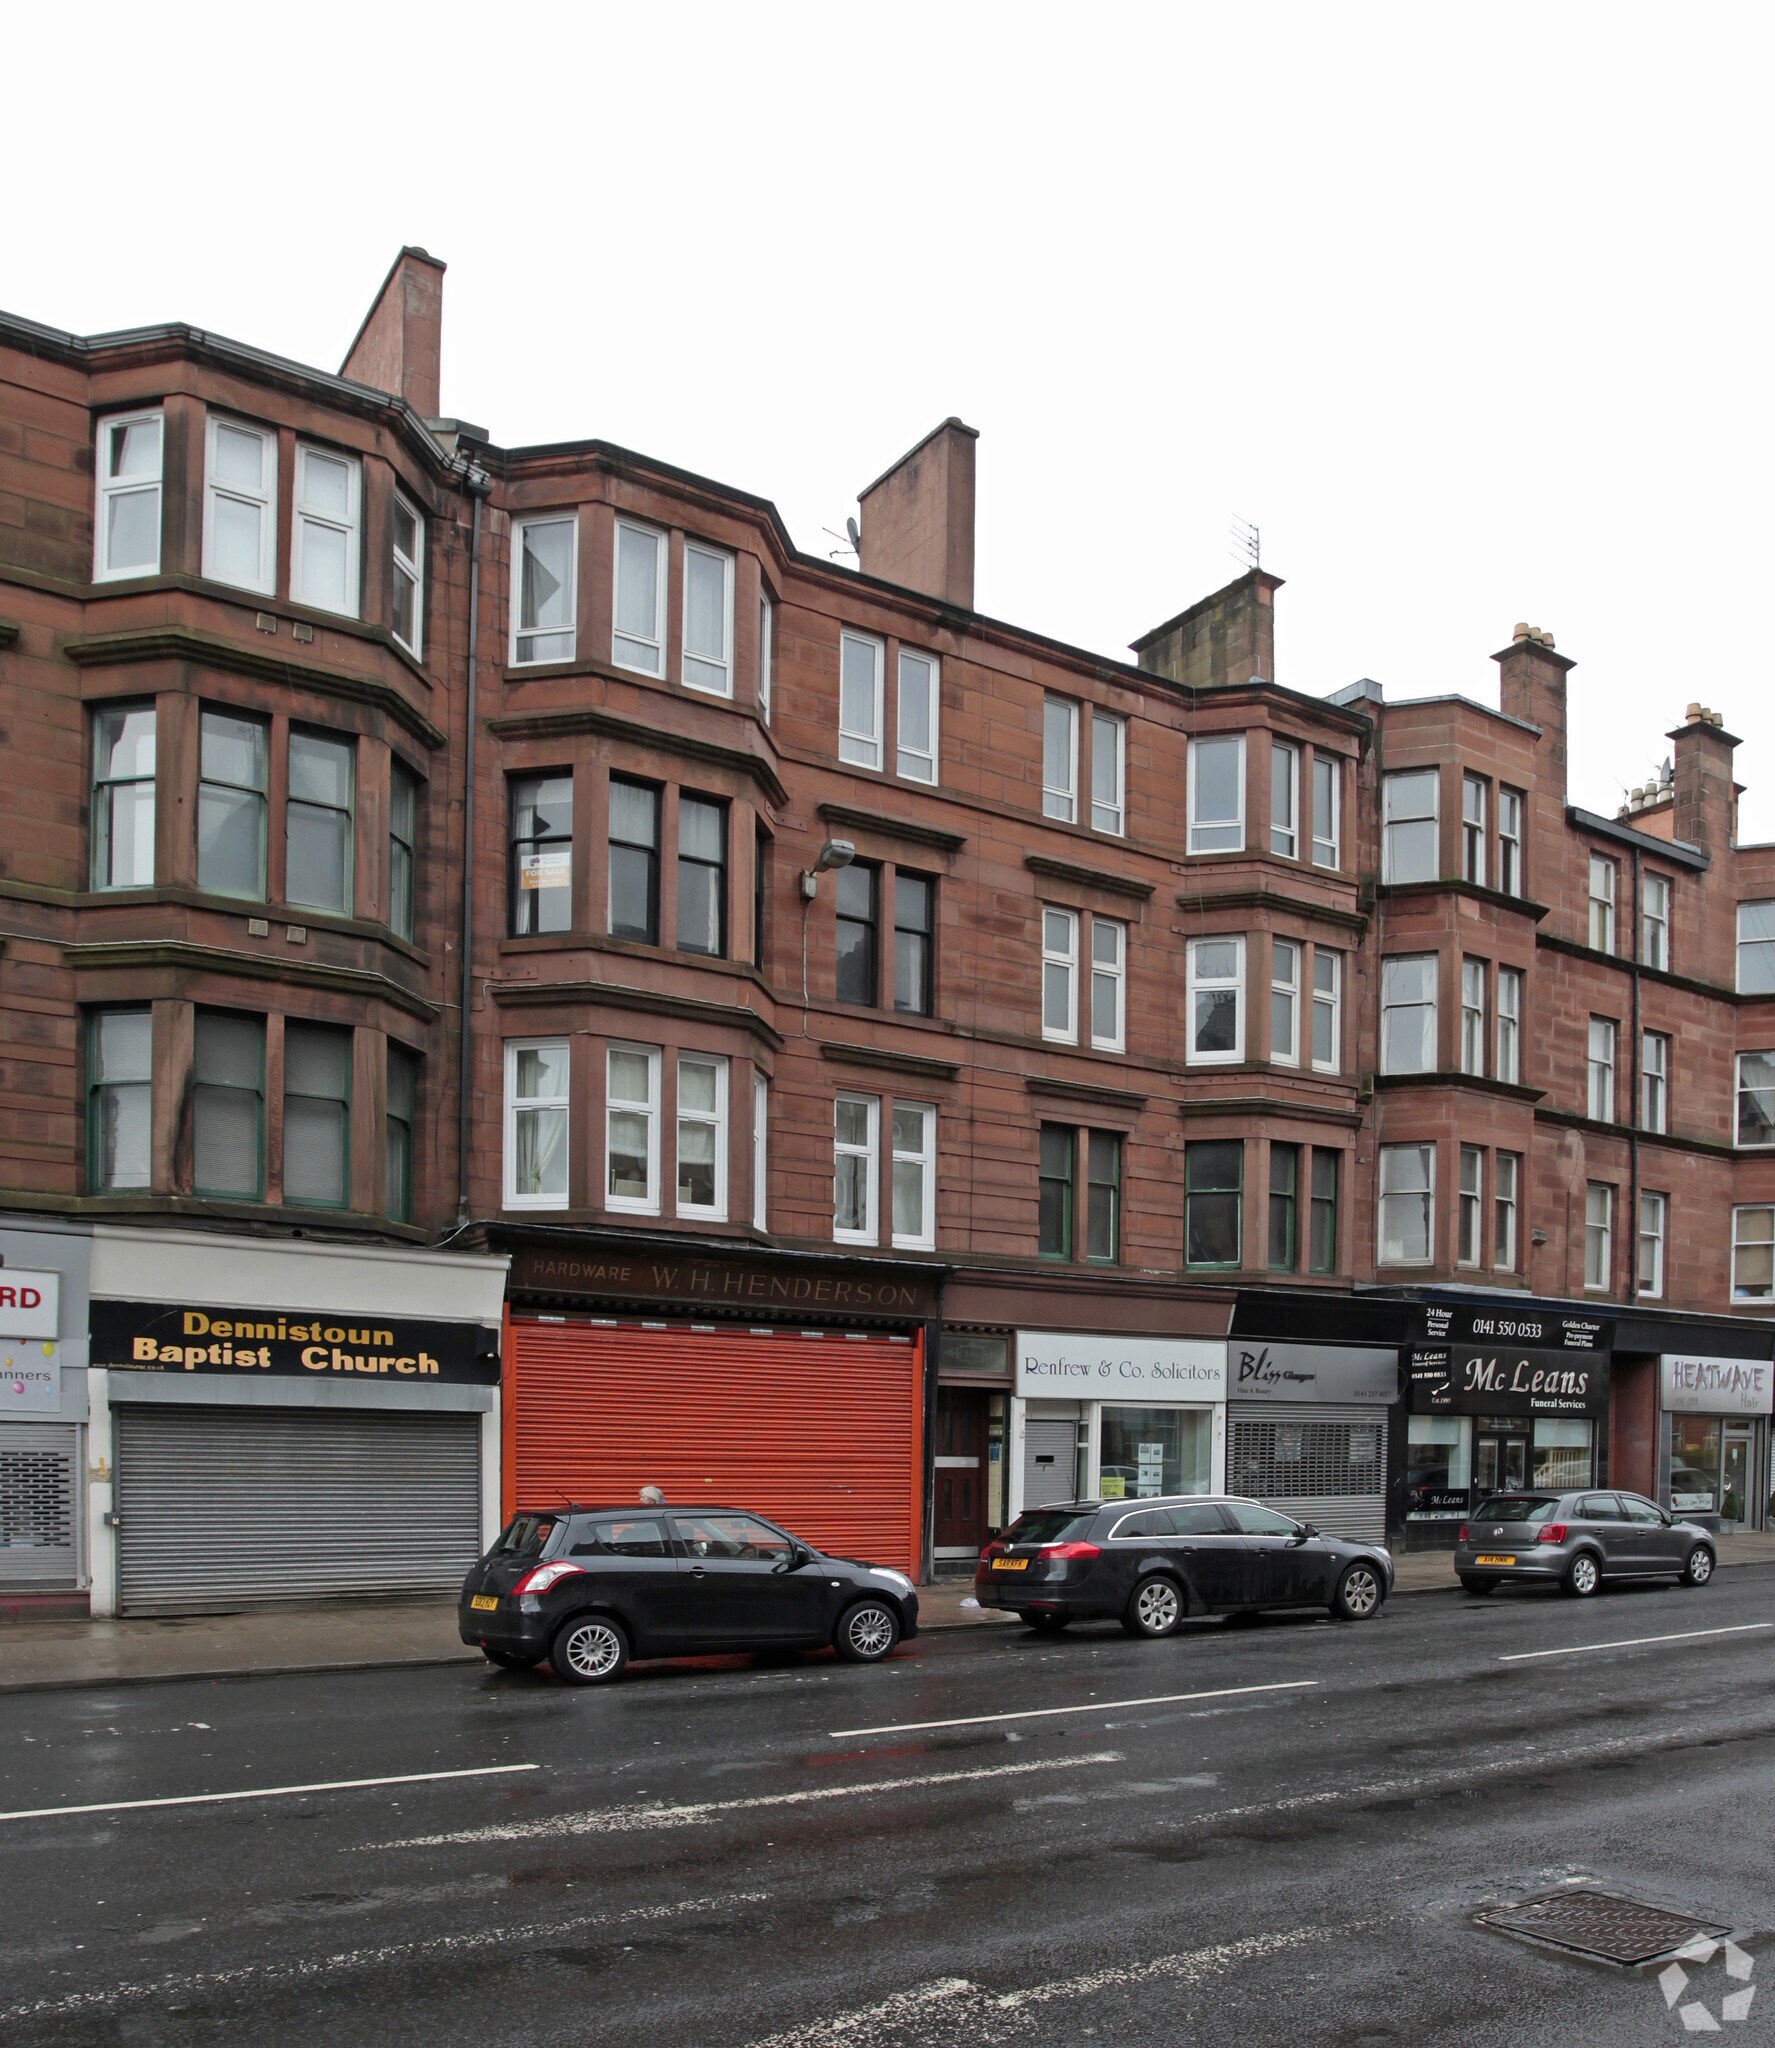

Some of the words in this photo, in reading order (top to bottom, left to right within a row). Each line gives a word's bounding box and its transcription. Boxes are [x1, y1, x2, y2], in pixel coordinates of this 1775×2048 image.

[532, 1260, 632, 1281] HARDWARE
[651, 1265, 679, 1289] W.
[690, 1269, 715, 1292] H.
[723, 1272, 918, 1306] HENDERSON
[1426, 1308, 1435, 1317] 24
[1436, 1309, 1453, 1318] Hour
[183, 1312, 394, 1346] Dennistoun
[1427, 1321, 1449, 1329] Personal
[1473, 1319, 1495, 1334] 0141
[1497, 1321, 1516, 1336] 550
[1518, 1323, 1542, 1338] 0533
[1562, 1321, 1580, 1329] Golden
[1581, 1323, 1600, 1331] Charter
[133, 1337, 271, 1370] Baptist
[301, 1346, 439, 1374] Church
[1238, 1347, 1281, 1384] Bliss
[1024, 1357, 1091, 1377] Renfrew
[1098, 1360, 1112, 1377] &
[1119, 1361, 1145, 1378] Co.
[1151, 1361, 1221, 1380] Solicitors
[1673, 1361, 1765, 1392] HEATWAVE
[1531, 1398, 1557, 1408] Funeral
[1558, 1399, 1586, 1409] Services
[1740, 1392, 1760, 1409] Hair
